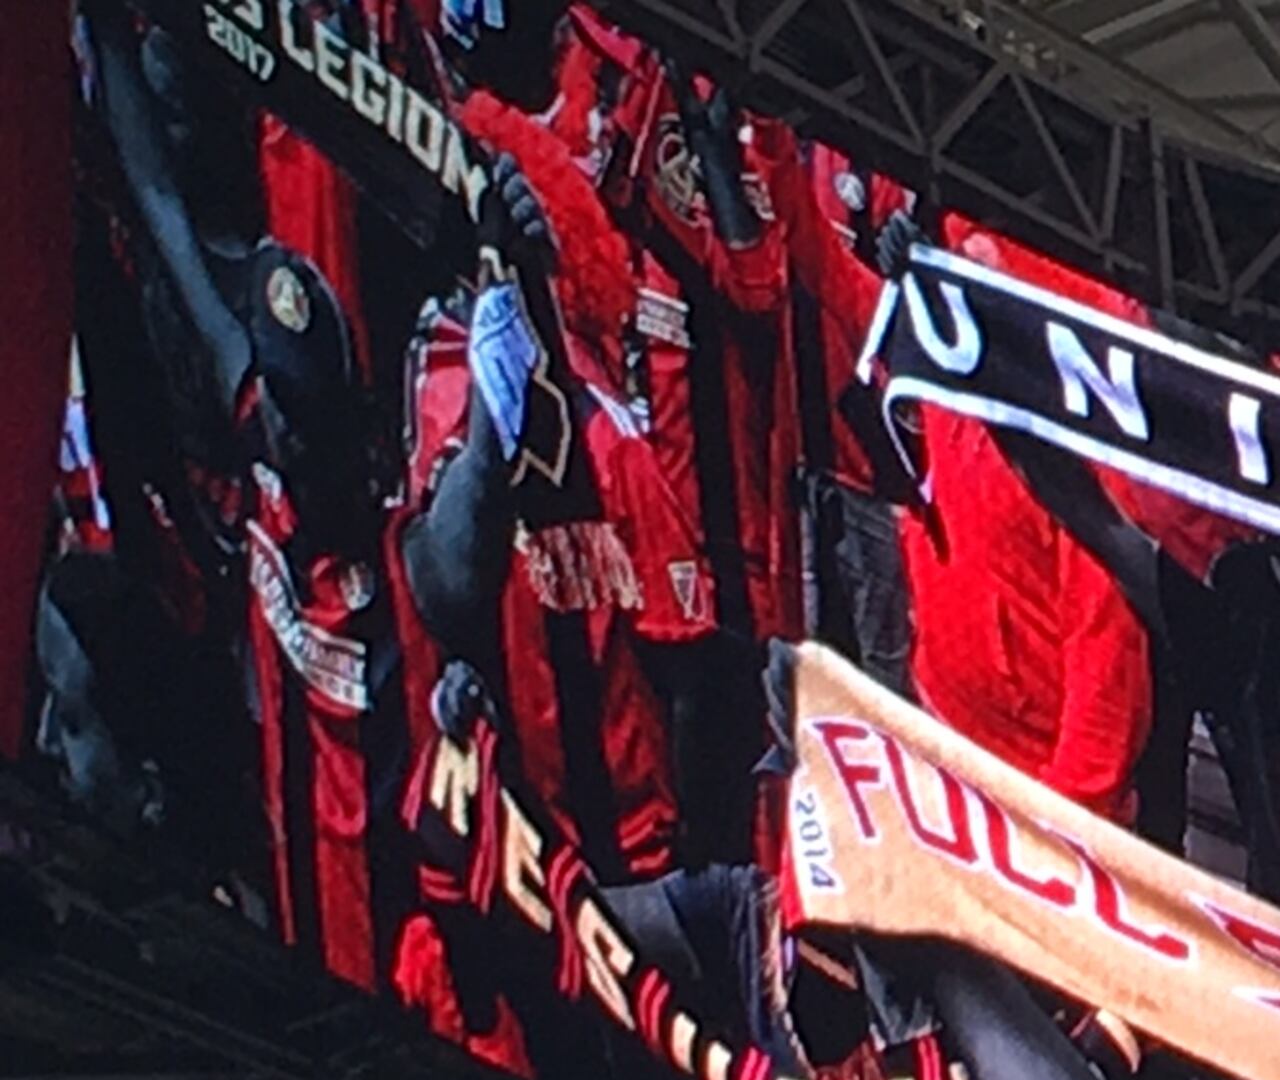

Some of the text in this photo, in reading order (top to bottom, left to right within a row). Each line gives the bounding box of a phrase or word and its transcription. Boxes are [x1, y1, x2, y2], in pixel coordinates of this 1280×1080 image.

[278, 0, 488, 224] LEGION
[796, 792, 836, 890] 2014
[803, 715, 1197, 962] FULL
